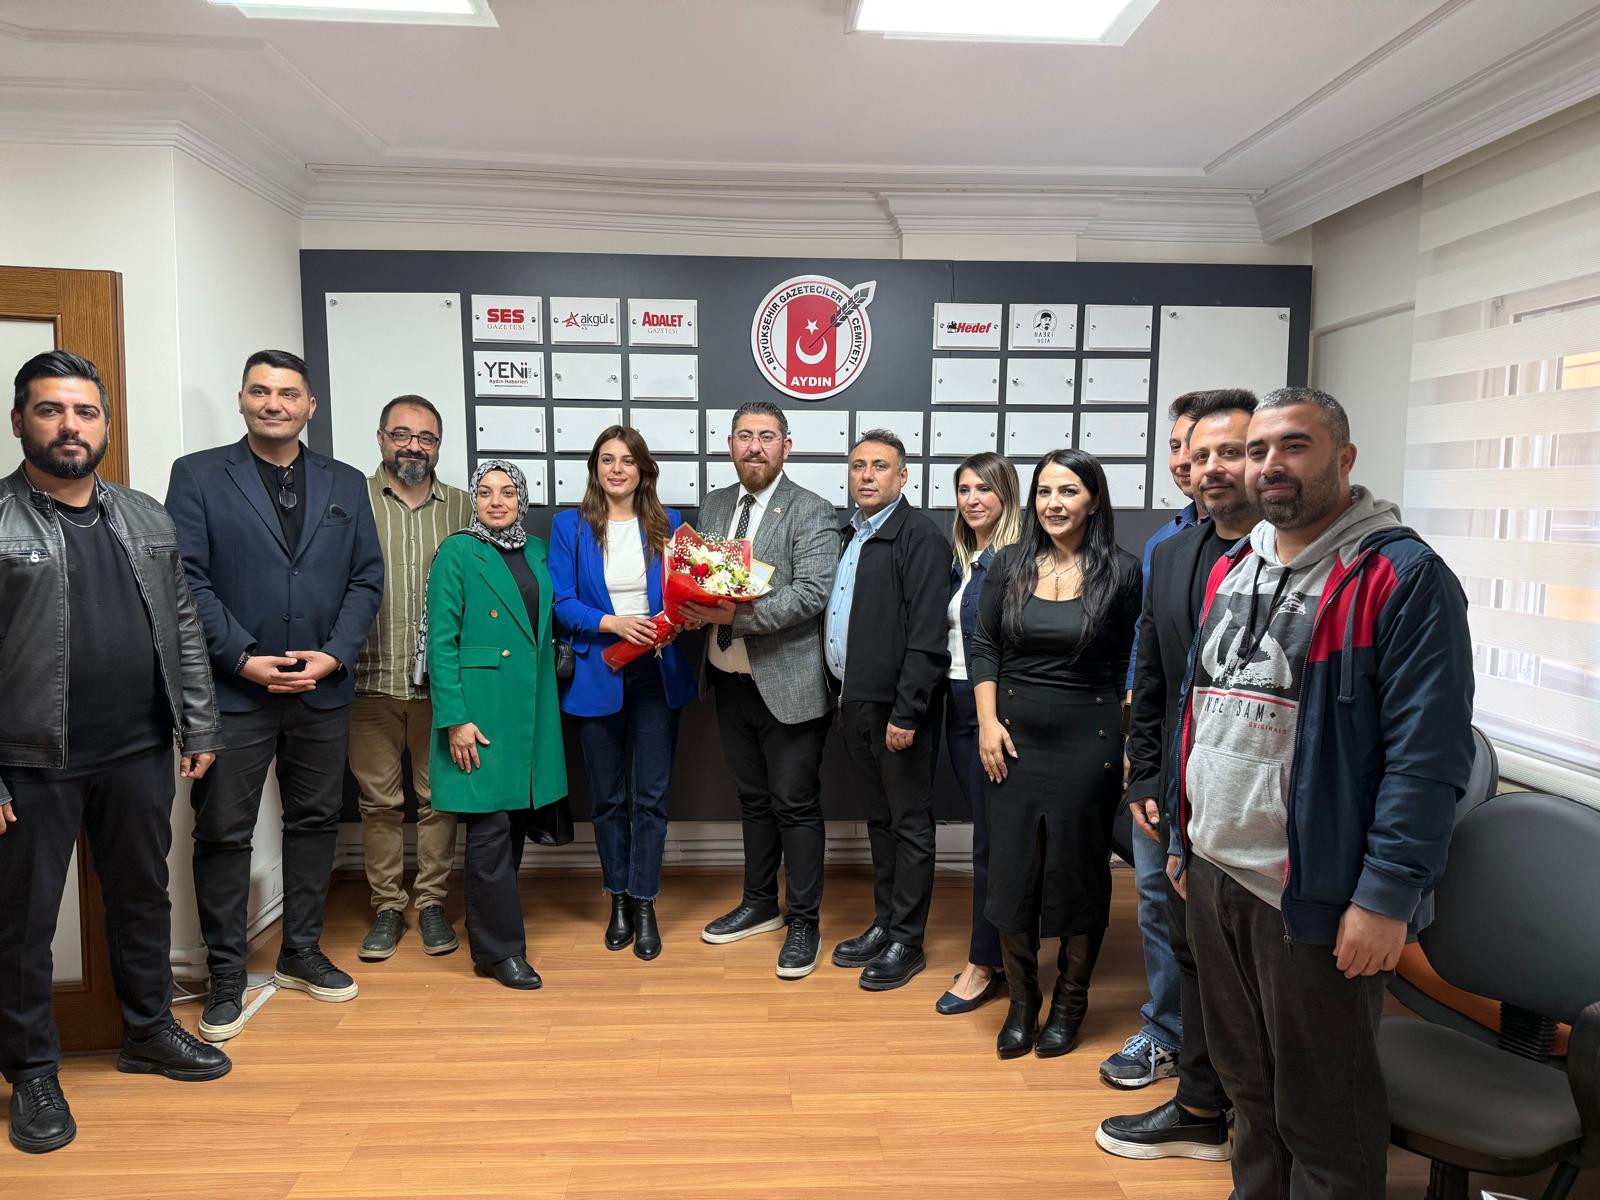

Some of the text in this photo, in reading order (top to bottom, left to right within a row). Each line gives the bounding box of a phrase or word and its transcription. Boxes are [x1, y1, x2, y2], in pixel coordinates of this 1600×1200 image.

[487, 308, 525, 324] SES
[580, 313, 609, 327] akgül
[760, 302, 780, 364] BÜYÜKŞEHİR
[779, 286, 843, 303] GAZETECİLER
[956, 323, 992, 333] Hedef
[791, 377, 831, 386] AYDIN
[1237, 701, 1264, 722] SAM
